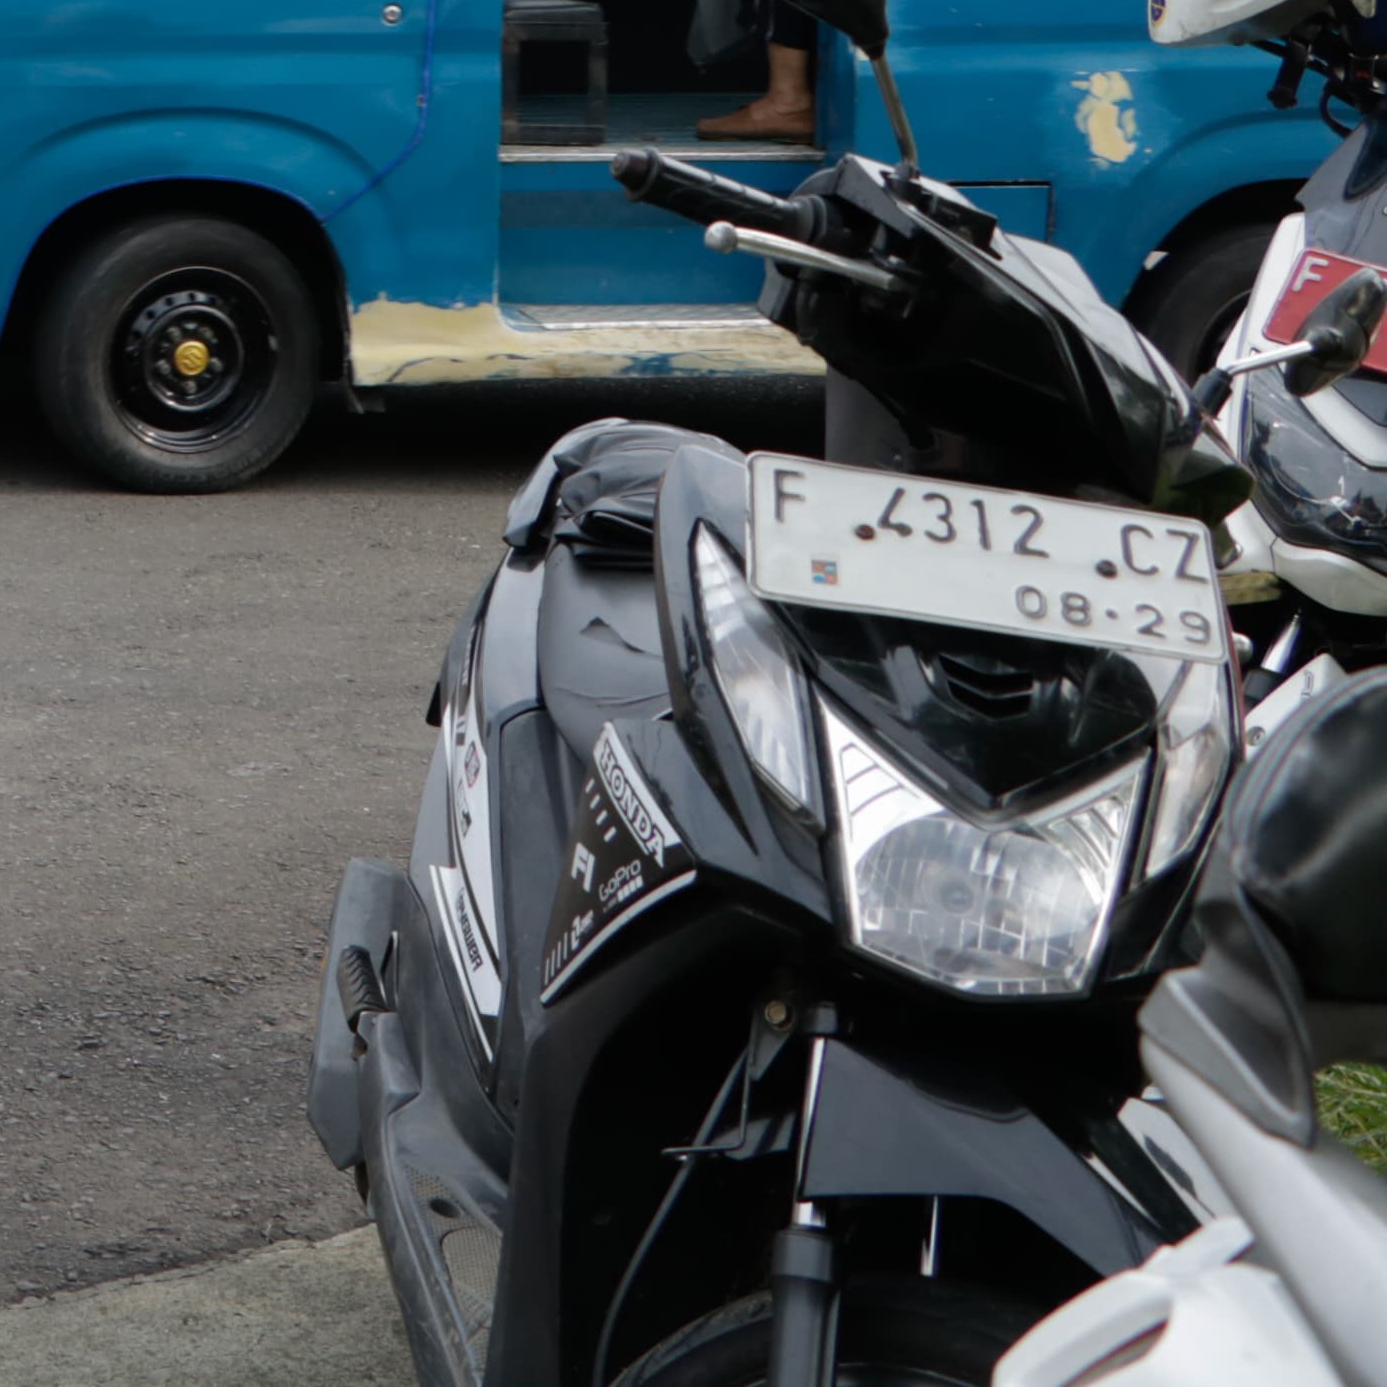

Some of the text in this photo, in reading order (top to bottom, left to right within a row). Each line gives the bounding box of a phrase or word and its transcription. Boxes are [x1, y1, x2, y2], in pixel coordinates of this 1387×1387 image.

[1290, 257, 1330, 294] F
[773, 469, 1210, 585] F 4312 CZ
[598, 740, 666, 870] HONDA
[598, 859, 642, 902] GoPro
